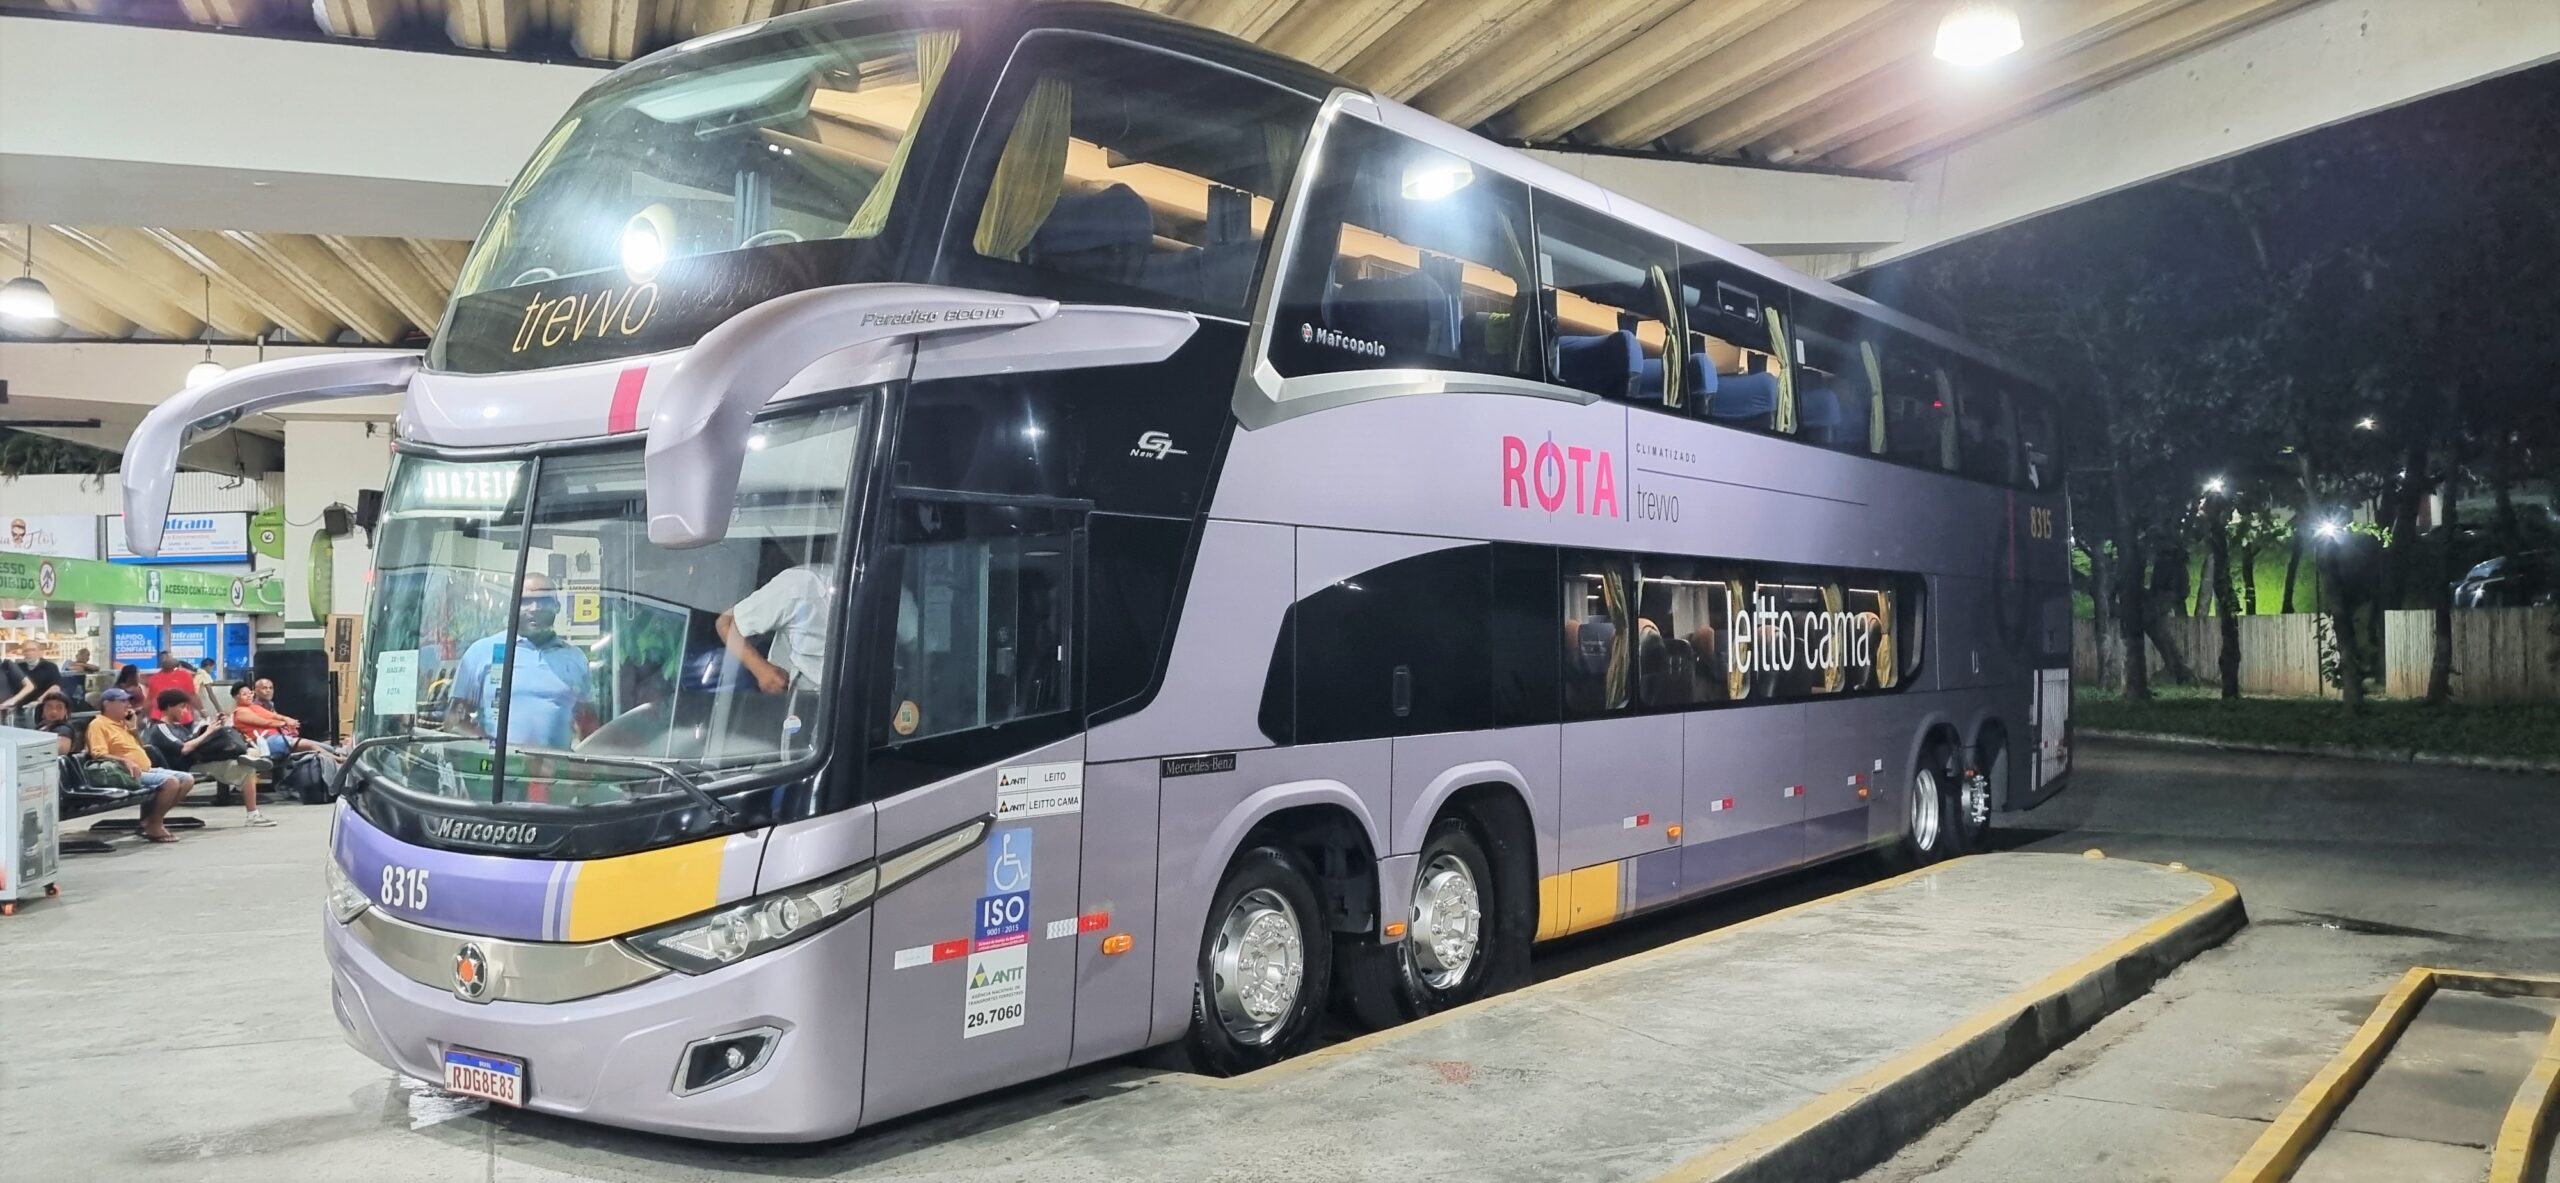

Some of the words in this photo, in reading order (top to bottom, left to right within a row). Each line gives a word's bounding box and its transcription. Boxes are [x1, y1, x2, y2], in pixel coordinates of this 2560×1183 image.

[512, 282, 658, 353] trevvo
[860, 309, 938, 327] Paradiso
[1316, 327, 1386, 357] Marcopolo
[1635, 442, 1697, 464] CLIMATIZADO
[1502, 435, 1618, 518] ROTA
[1636, 484, 1680, 523] trevvo
[2030, 505, 2052, 539] 8315
[165, 584, 188, 595] ACESSO
[574, 593, 600, 623] B
[1727, 590, 1795, 673] leitto
[1804, 611, 1871, 670] cama
[1044, 771, 1066, 782] LEITO
[1166, 757, 1234, 776] Mercedes-Benz
[1009, 777, 1026, 786] ANTT
[1009, 803, 1026, 812] ANTT
[1029, 798, 1056, 810] LEITTO
[1057, 796, 1079, 807] CAMA
[438, 818, 537, 845] Marcopolo
[381, 864, 430, 911] 8315
[983, 895, 1025, 928] ISO
[990, 965, 1024, 986] ANTT
[967, 1003, 1022, 1029] 29.7060
[453, 1066, 514, 1100] RDG8E83
